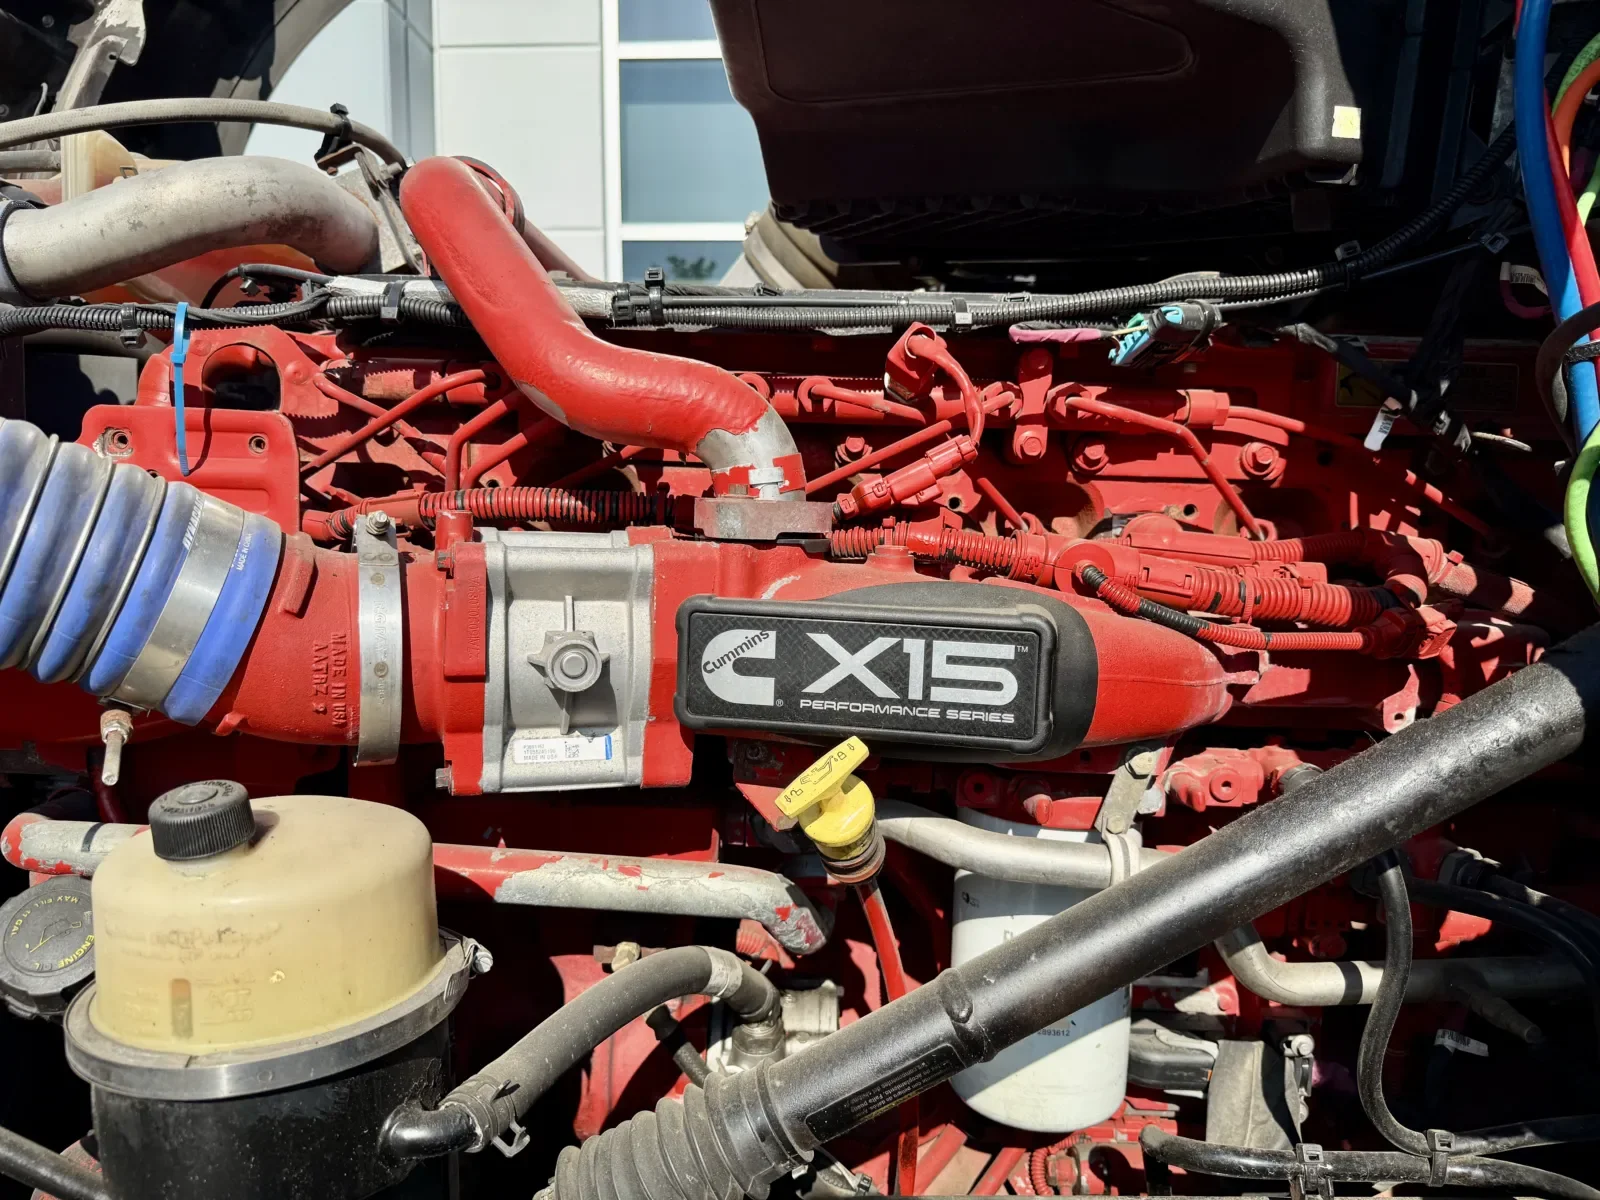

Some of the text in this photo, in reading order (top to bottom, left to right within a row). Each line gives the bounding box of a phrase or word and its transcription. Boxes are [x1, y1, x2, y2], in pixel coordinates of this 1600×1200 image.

[702, 630, 770, 674] Cummins
[800, 632, 1018, 706] X15
[331, 633, 348, 728] MADE IN USA
[800, 700, 1014, 724] PERFORMANCE SERIES
[57, 896, 79, 904] MAX
[58, 934, 95, 968] ENGINE
